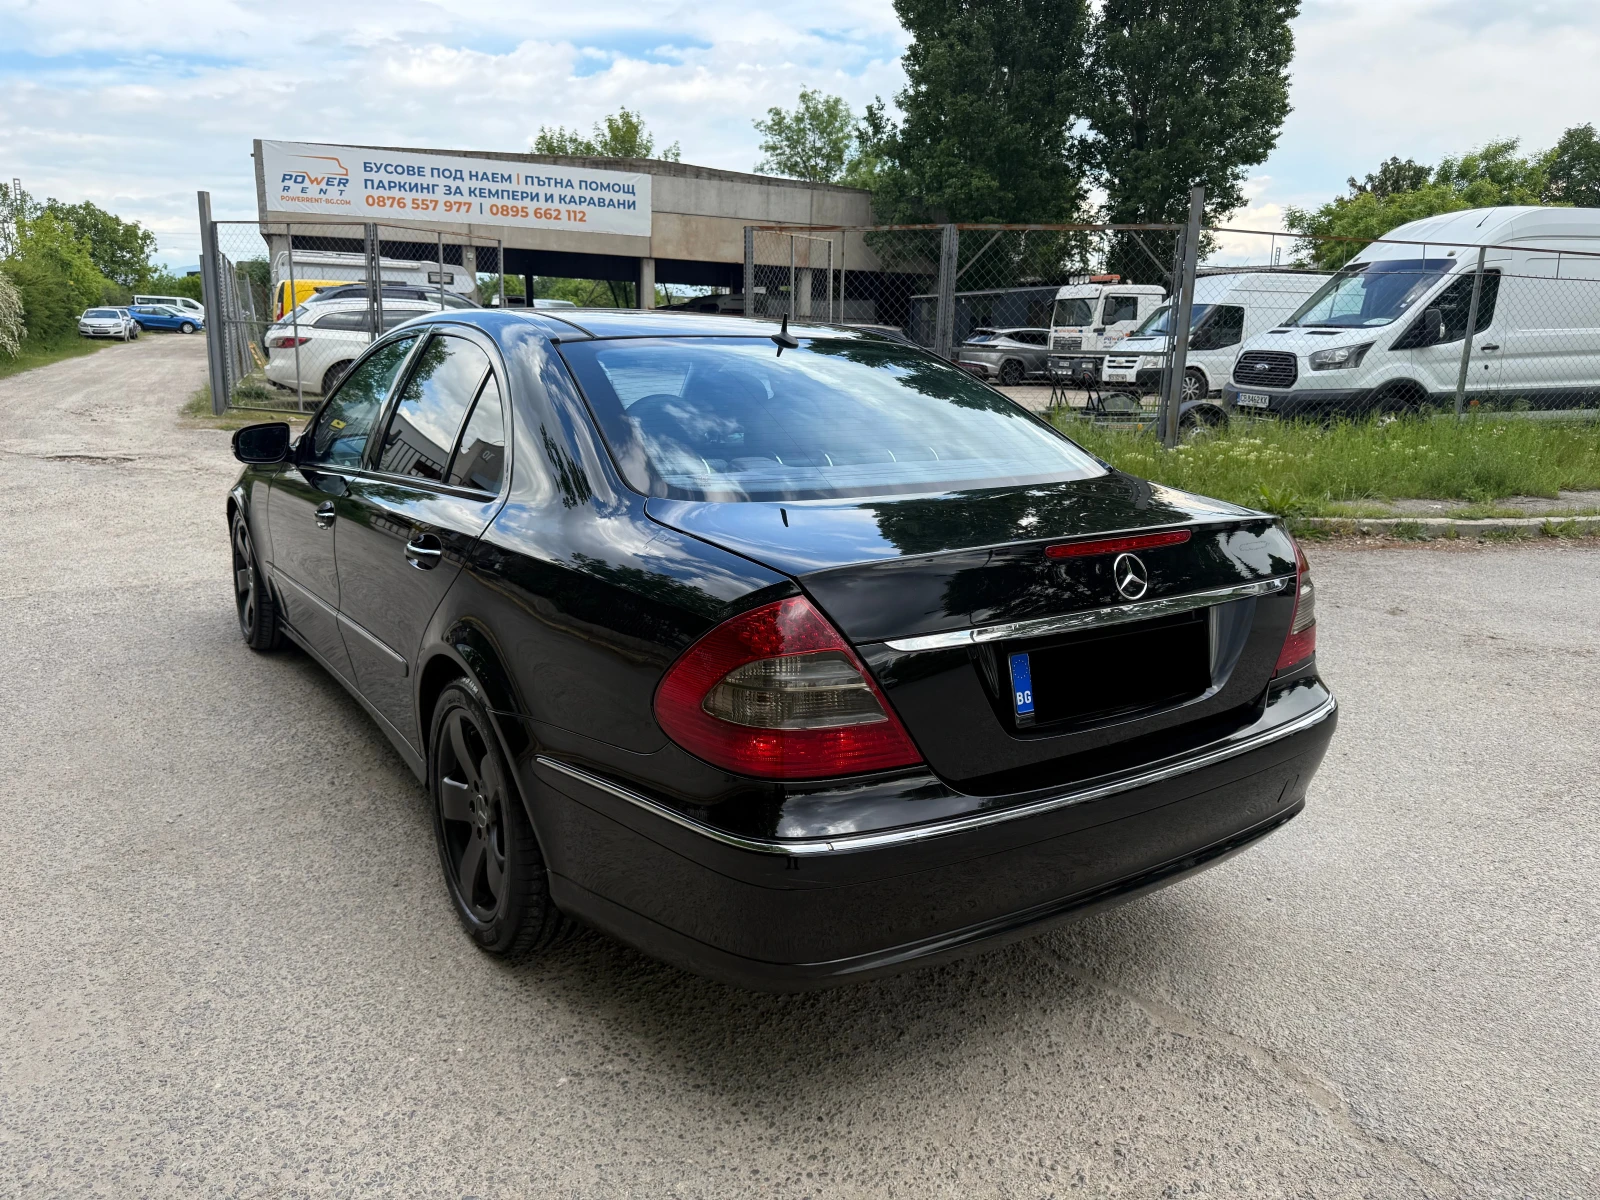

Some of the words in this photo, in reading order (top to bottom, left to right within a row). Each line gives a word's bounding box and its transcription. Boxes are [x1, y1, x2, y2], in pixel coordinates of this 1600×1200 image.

[281, 172, 350, 188] POWER
[363, 161, 426, 177] БУСОВЕ
[430, 167, 465, 182] ПОД
[468, 170, 512, 184] НАЕМ
[524, 175, 575, 190] ПЪТНА
[578, 179, 636, 196] ПОМОЩ
[282, 185, 346, 196] RENT
[363, 178, 439, 195] ПАРКИНГ
[443, 184, 464, 197] ЗА
[468, 187, 540, 203] КЕМПЕРИ
[544, 192, 554, 203] И
[558, 194, 636, 211] КАРАВАНИ
[280, 195, 352, 206] POWERRENT-BG.COM
[365, 194, 407, 209] 0876
[411, 197, 439, 211] 557
[443, 200, 472, 214] 977
[489, 203, 529, 219] 0895
[533, 207, 562, 221] 662
[565, 209, 587, 223] 112
[1016, 690, 1032, 706] BG
